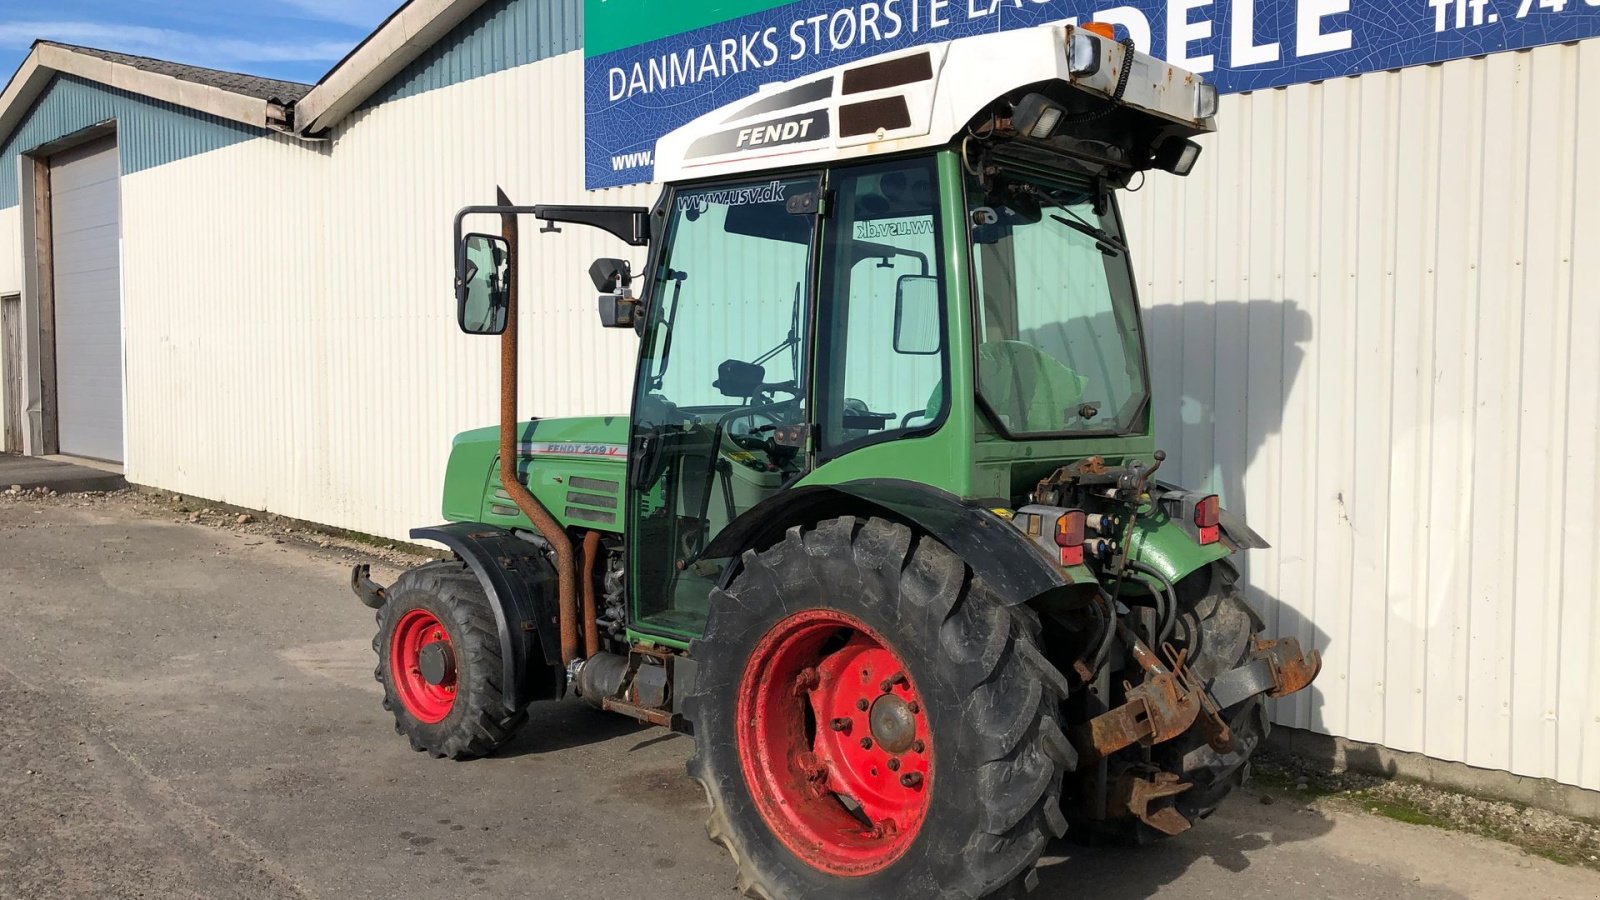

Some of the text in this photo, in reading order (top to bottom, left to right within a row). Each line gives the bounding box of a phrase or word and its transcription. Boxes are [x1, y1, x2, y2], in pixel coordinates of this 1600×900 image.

[608, 0, 950, 101] DANMARKS STØRSTE
[1038, 0, 1353, 74] DELE
[735, 118, 814, 148] FENDT
[676, 180, 787, 212] www.usv.dk
[547, 444, 619, 456] FENDT 209 V
